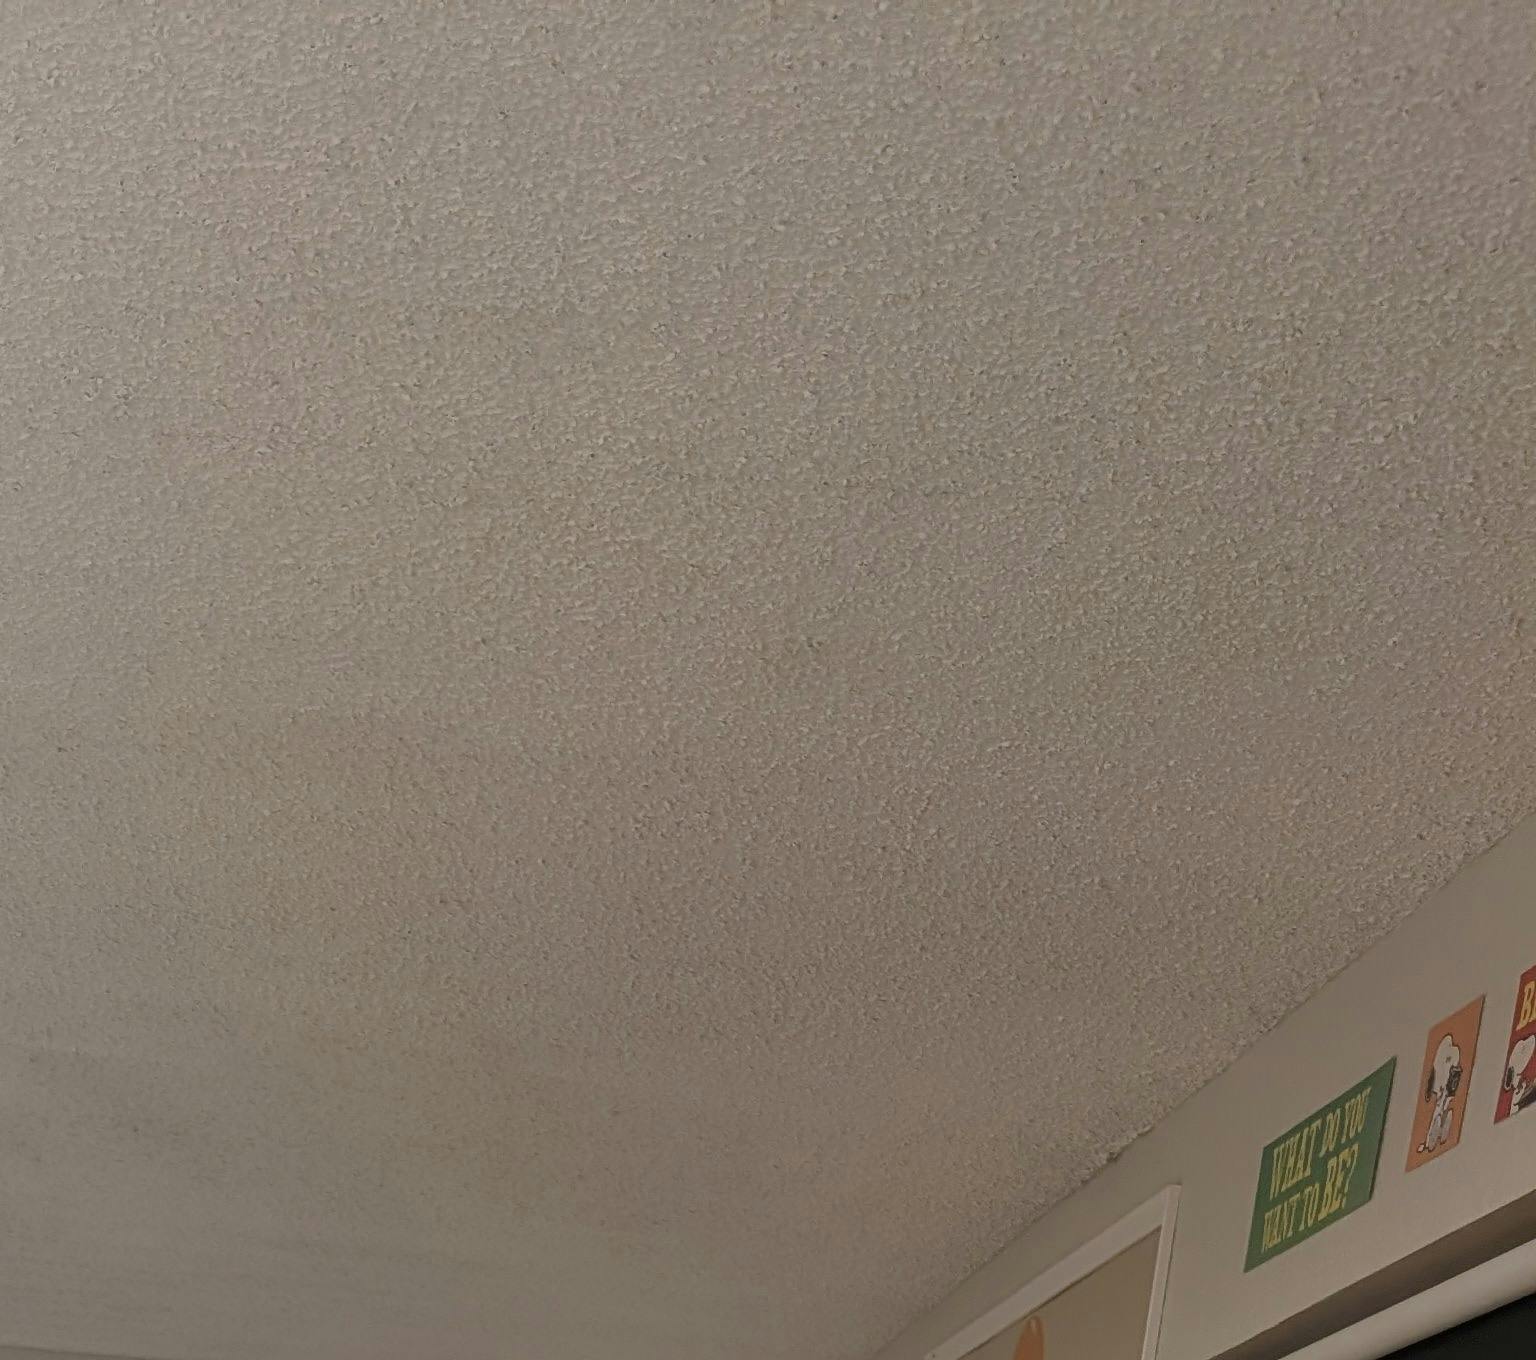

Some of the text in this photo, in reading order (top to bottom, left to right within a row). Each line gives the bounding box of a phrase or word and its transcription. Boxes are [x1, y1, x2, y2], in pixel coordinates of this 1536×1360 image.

[1262, 1143, 1359, 1253] WANT TO BE?
[1270, 1087, 1371, 1200] WHAT DO YOU
